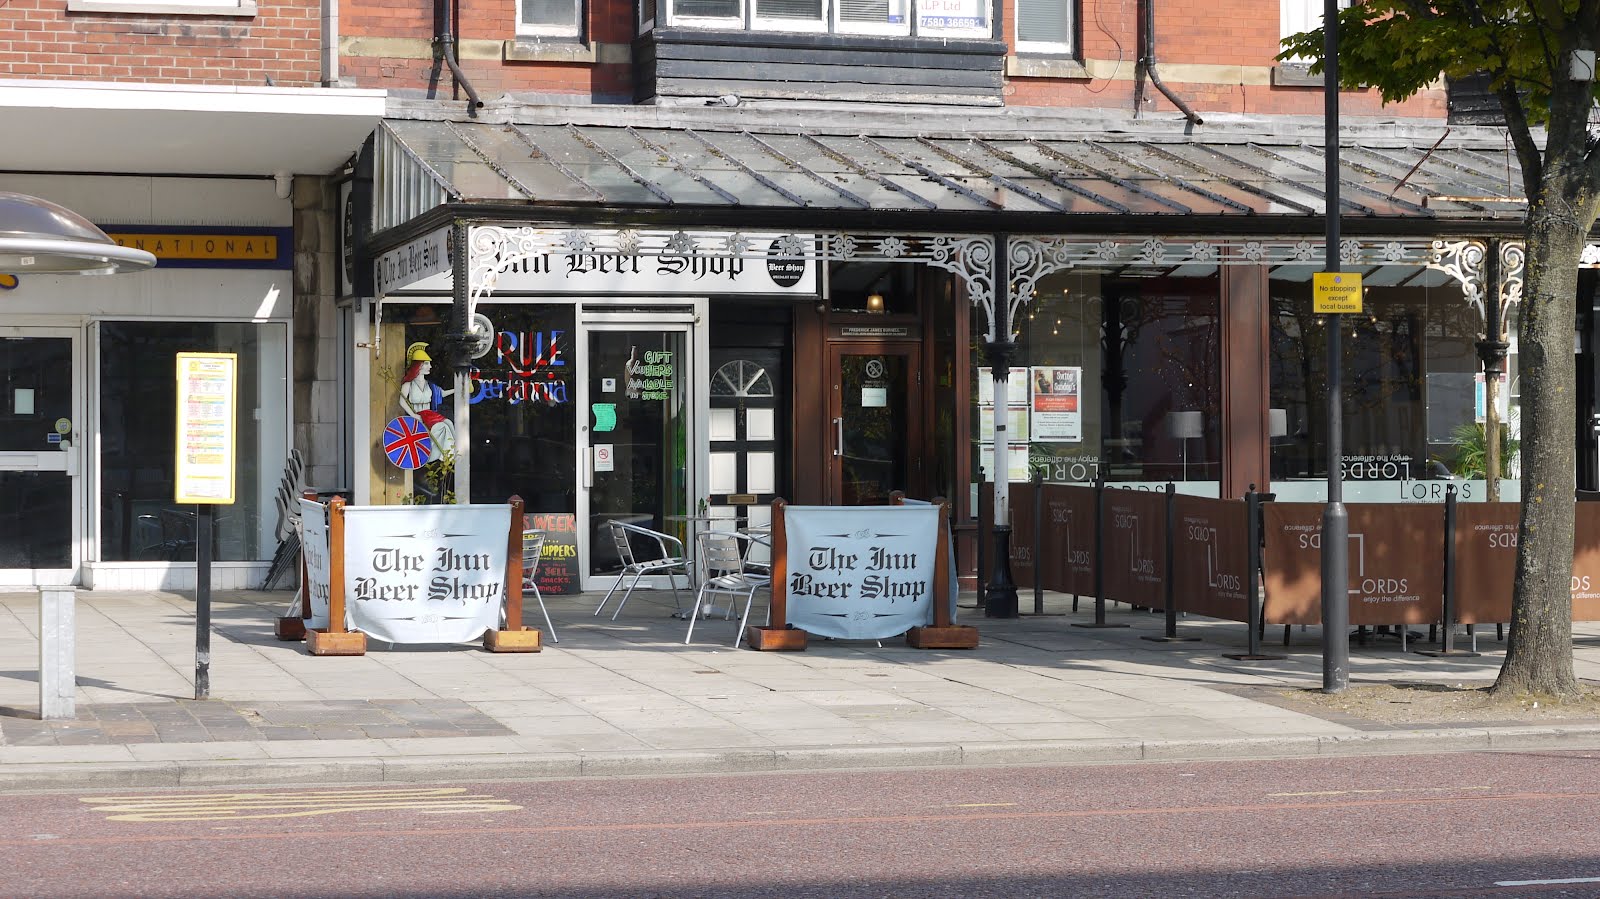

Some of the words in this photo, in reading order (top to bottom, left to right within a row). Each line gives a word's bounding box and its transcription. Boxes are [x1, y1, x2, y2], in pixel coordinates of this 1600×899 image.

[921, 1, 938, 10] LP
[943, 0, 960, 10] Ltd
[566, 246, 643, 278] Beer
[656, 243, 744, 281] Shop
[768, 263, 785, 271] Beer
[786, 263, 804, 272] Shop
[496, 330, 566, 372] RULE
[645, 351, 673, 364] GIFT
[1401, 480, 1471, 499] LORDS
[373, 547, 425, 577] The
[432, 547, 490, 572] Inn
[809, 546, 858, 576] The
[865, 546, 917, 571] Inn
[1208, 544, 1240, 590] LORDS
[354, 576, 420, 601] Beer
[428, 576, 500, 606] Shop
[790, 572, 853, 599] Beer
[860, 575, 926, 603] Shop
